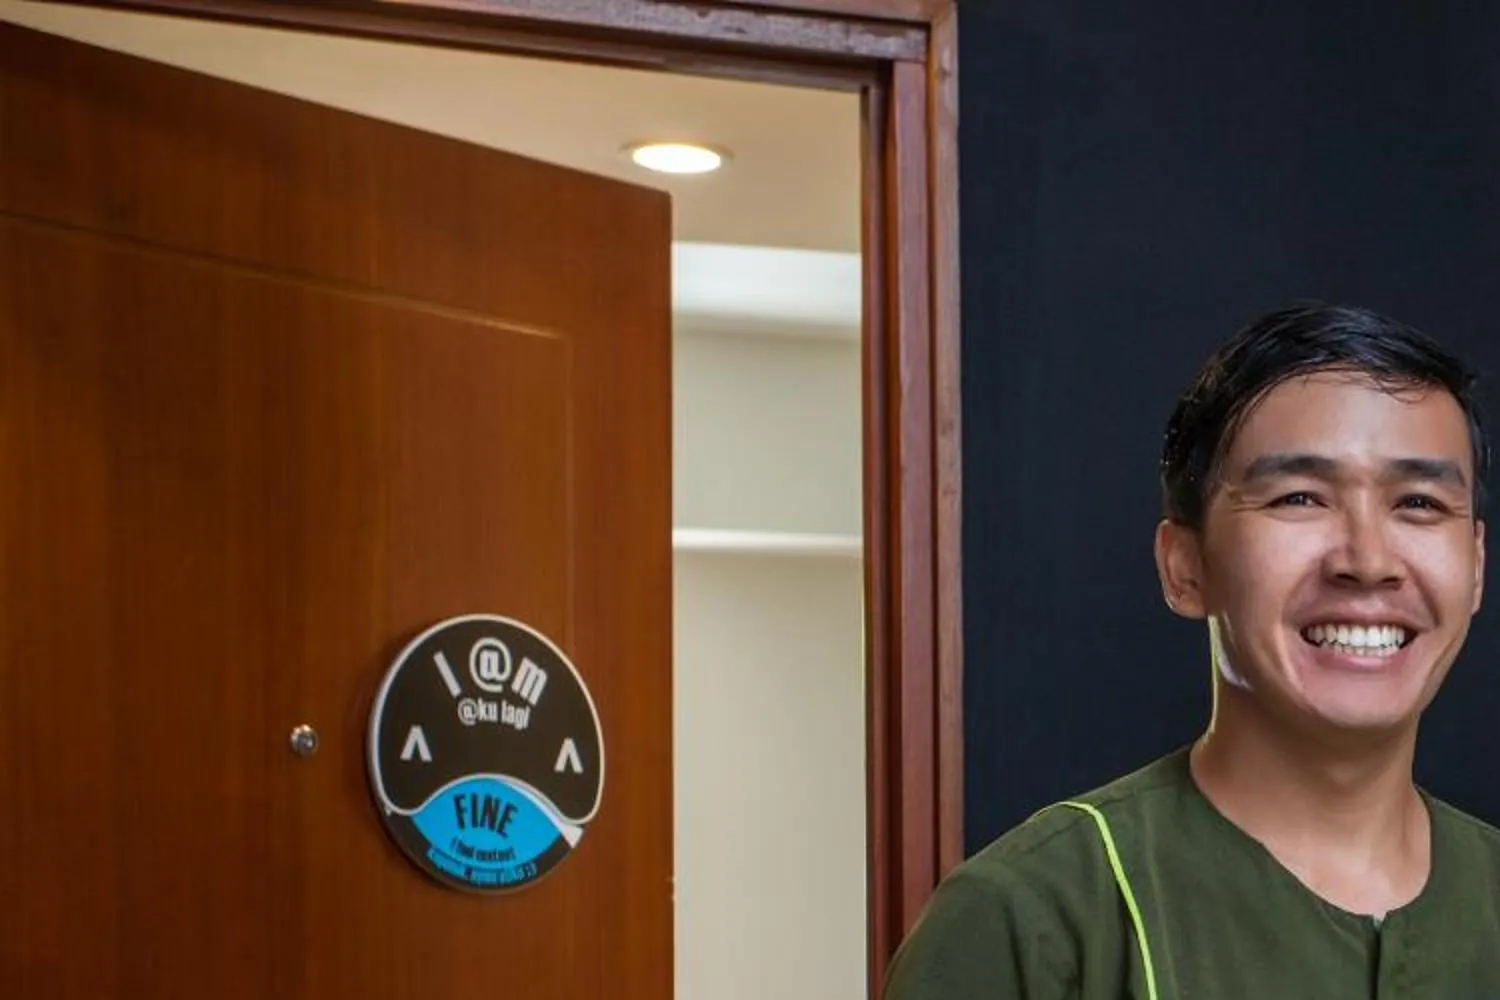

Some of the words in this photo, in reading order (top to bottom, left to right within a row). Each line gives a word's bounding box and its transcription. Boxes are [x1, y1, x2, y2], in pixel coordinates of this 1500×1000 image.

[433, 651, 462, 698] I
[469, 637, 548, 706] @m
[457, 697, 498, 727] @ku
[501, 699, 531, 730] lagi
[453, 792, 519, 839] FINE
